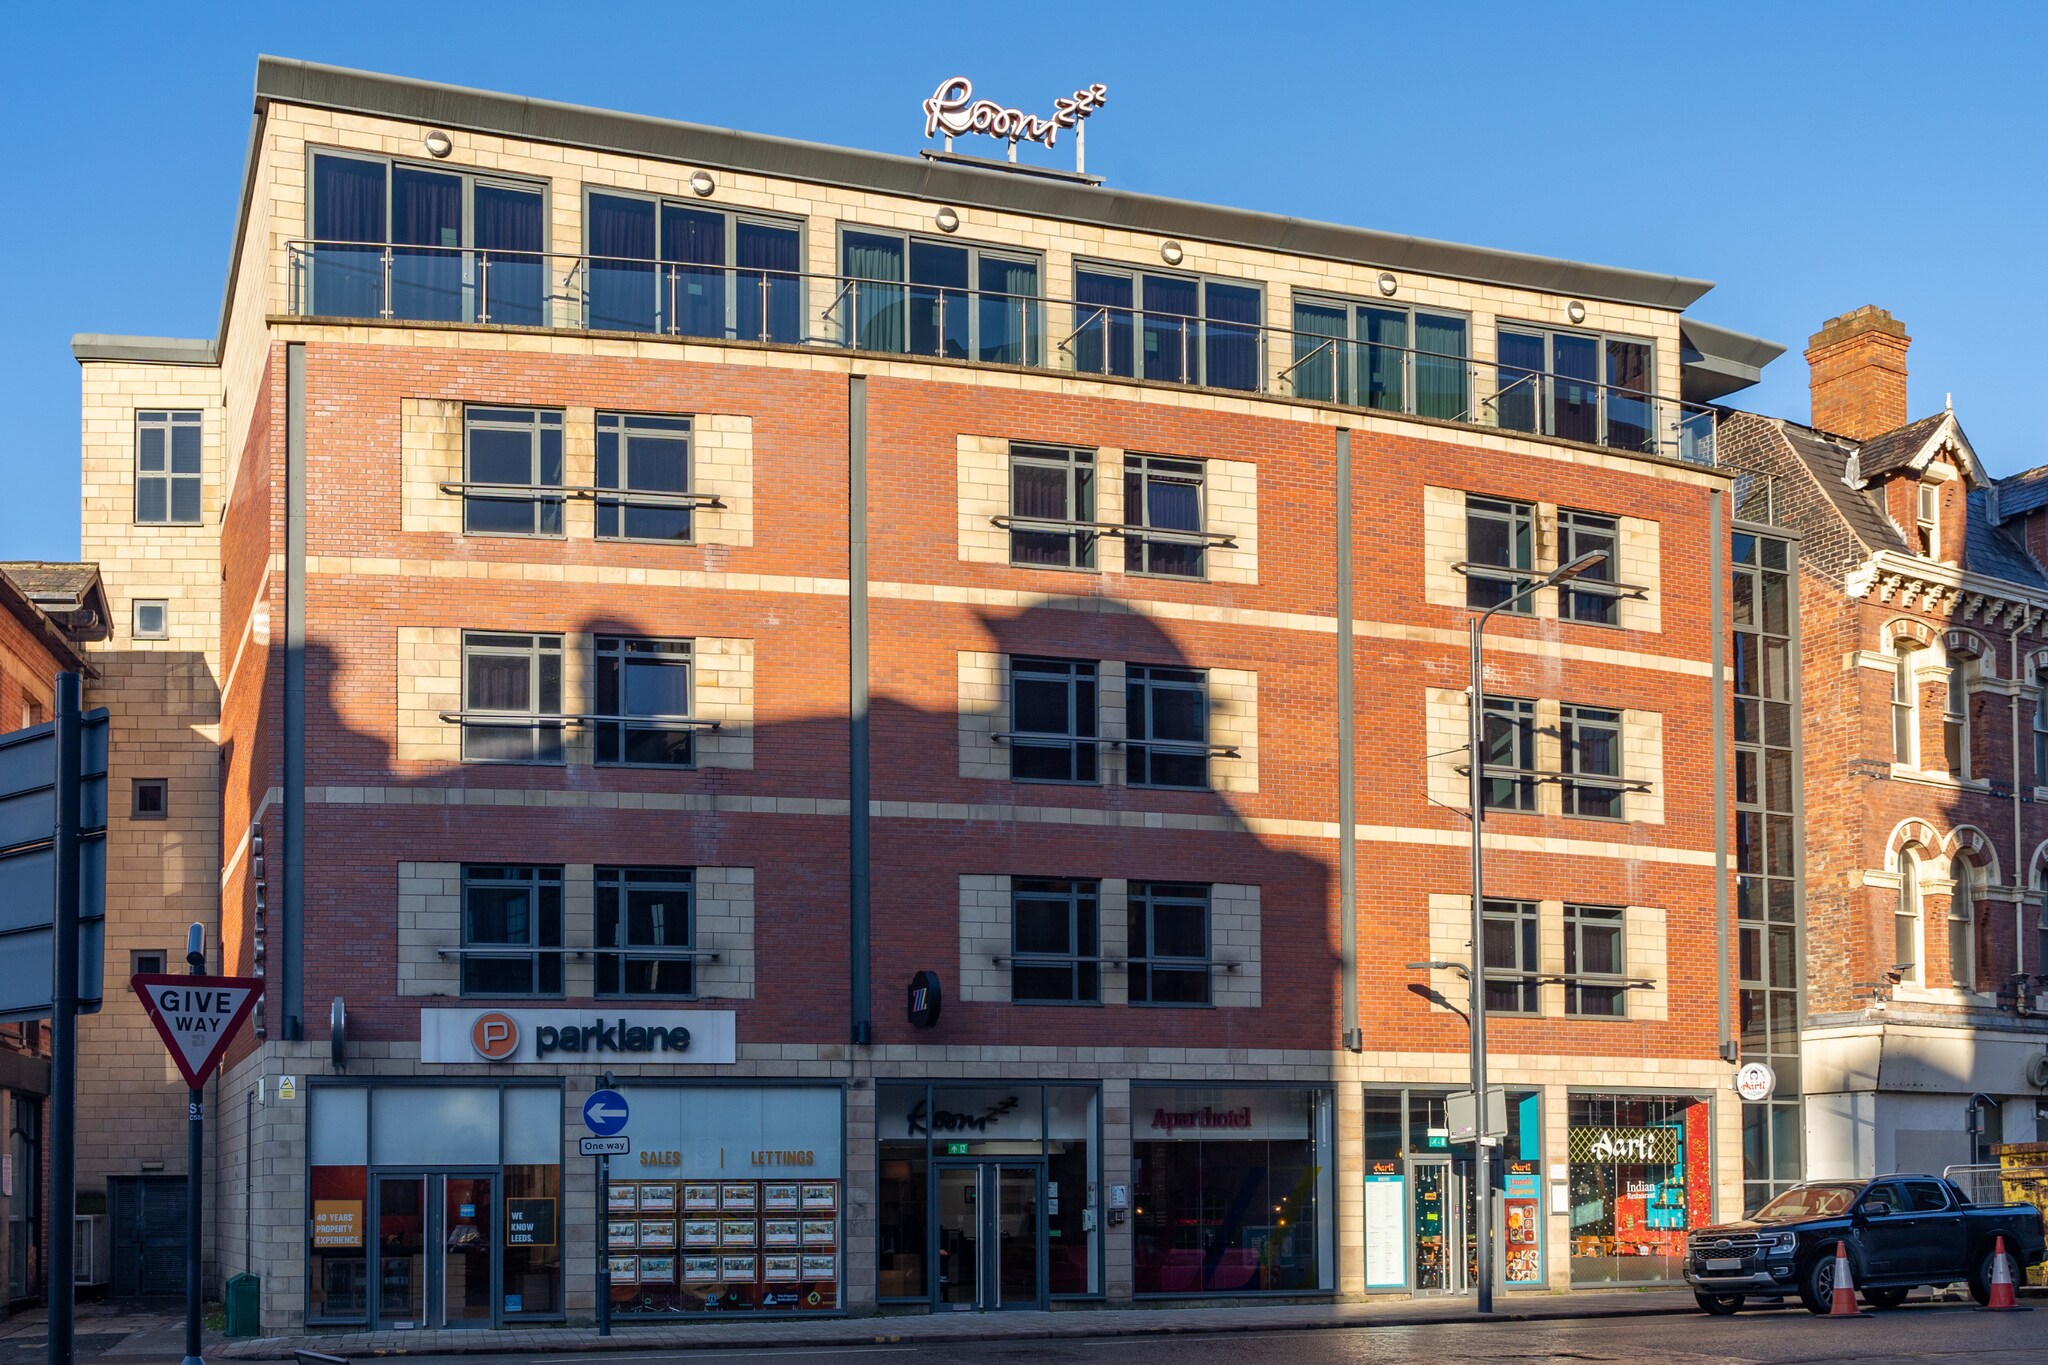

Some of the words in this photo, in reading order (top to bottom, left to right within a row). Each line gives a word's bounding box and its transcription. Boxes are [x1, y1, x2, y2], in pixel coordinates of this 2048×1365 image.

[160, 990, 231, 1013] GIVE
[175, 1016, 220, 1032] WAY
[536, 1018, 691, 1057] parklane
[1741, 1081, 1765, 1090] Aarti
[1151, 1106, 1252, 1136] Aparthotel
[585, 1142, 604, 1150] One
[606, 1142, 625, 1150] way
[1591, 1130, 1656, 1160] Aarti
[640, 1151, 681, 1165] SALES
[751, 1150, 814, 1165] LETTINGS
[1373, 1162, 1395, 1171] Aarti
[1511, 1162, 1531, 1171] Aarti
[1626, 1180, 1656, 1192] Indian
[1627, 1192, 1656, 1200] Restaurant
[316, 1213, 327, 1222] 40
[329, 1213, 355, 1222] YEARS'
[511, 1212, 523, 1220] WE
[316, 1225, 353, 1233] PROPERTY
[511, 1223, 534, 1232] KNOW
[316, 1236, 361, 1244] EXPERIENCE.
[511, 1234, 534, 1242] LEEDS.
